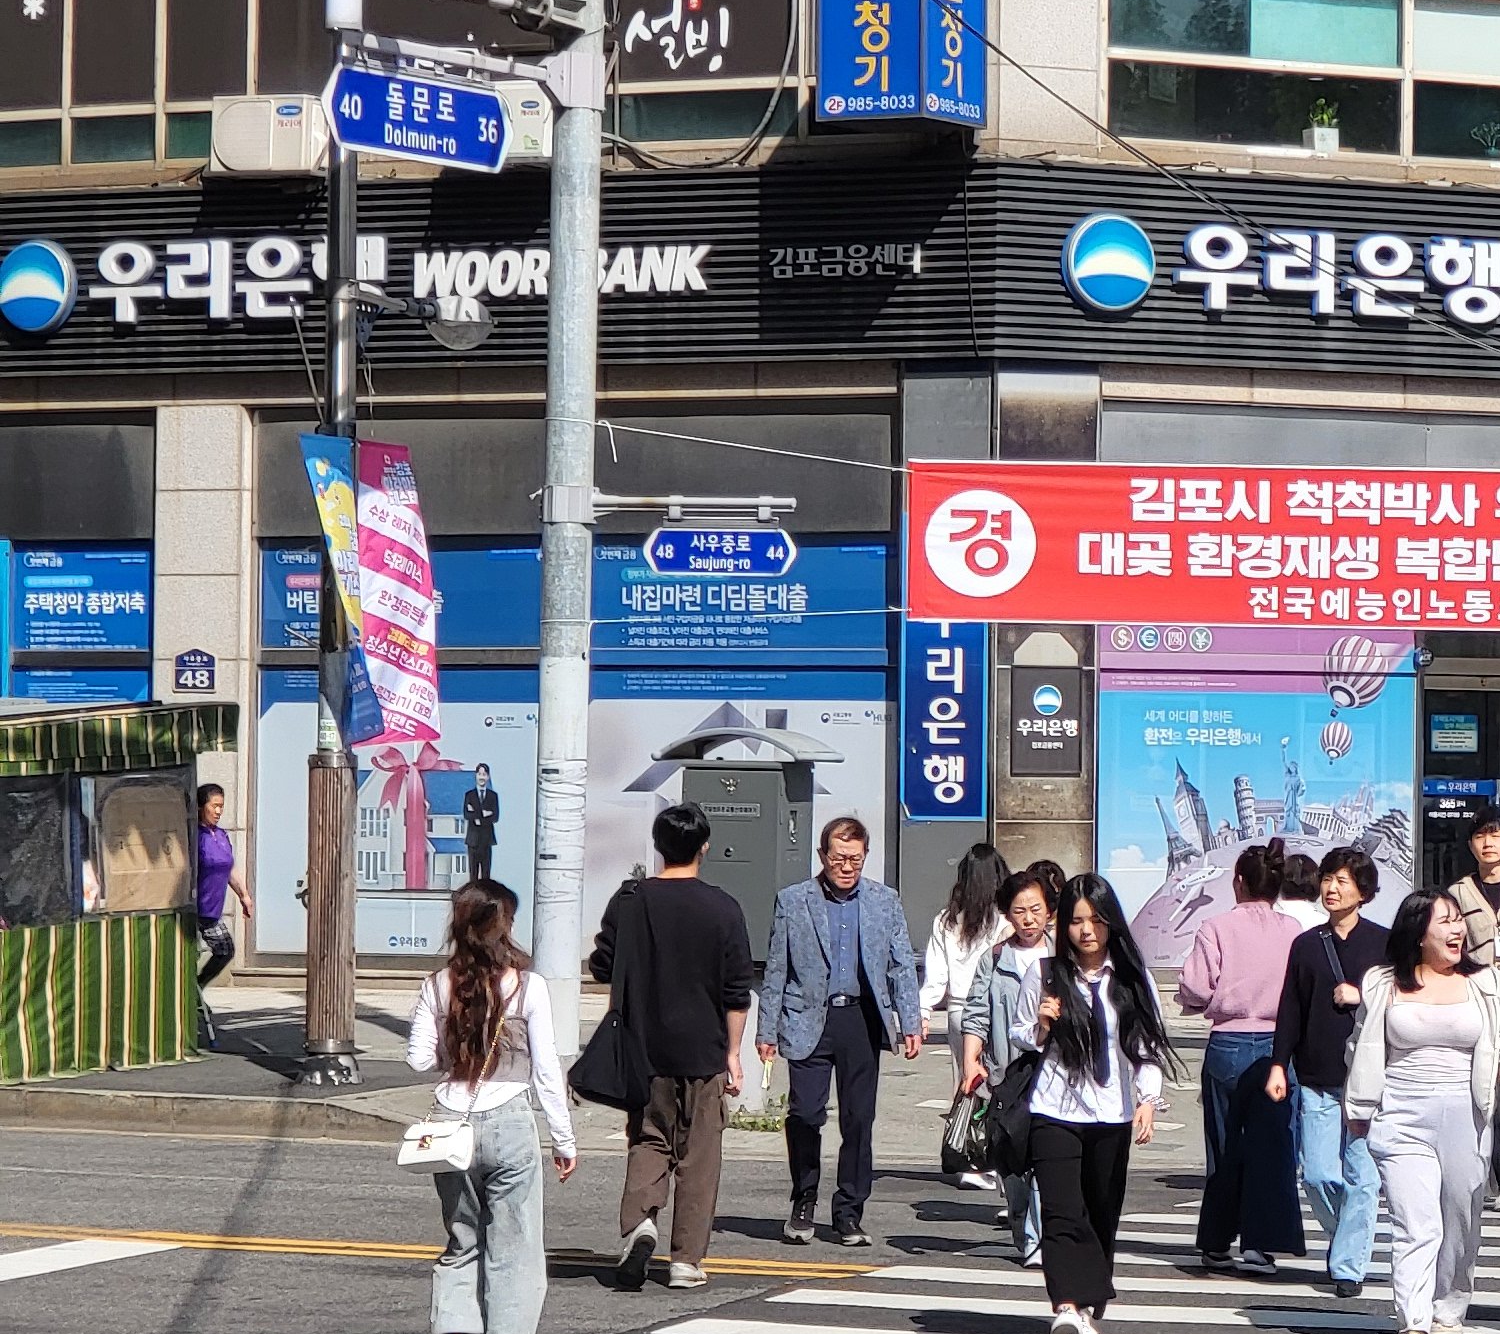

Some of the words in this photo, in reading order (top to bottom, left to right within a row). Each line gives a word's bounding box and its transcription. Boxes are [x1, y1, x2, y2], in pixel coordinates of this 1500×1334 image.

[339, 93, 362, 121] 40
[386, 78, 456, 124] 돌문로
[828, 98, 843, 112] 2F
[847, 95, 916, 113] 985-8033
[928, 95, 938, 110] 2F
[939, 98, 981, 119] 985-8033
[383, 122, 457, 155] Dolmun-ro
[477, 117, 498, 145] 36
[413, 248, 551, 299] WOOR
[768, 242, 922, 279] 김포금융센터
[1128, 478, 1271, 528] 김포시
[1287, 480, 1480, 529] 척척박사
[655, 544, 674, 559] 48
[690, 534, 752, 554] 사우중로
[765, 545, 785, 561] 44
[948, 509, 1012, 577] 경
[688, 555, 751, 573] Saujung-ro
[1077, 531, 1172, 577] 대곶
[1186, 532, 1379, 581] 환경재생
[24, 591, 84, 615] 주택청약
[86, 591, 147, 615] 종합저축
[621, 584, 701, 612] 내집마련
[706, 583, 809, 612] 디딤돌대출
[179, 670, 210, 688] 48
[1144, 710, 1166, 724] 세계
[1169, 710, 1198, 724] 어디를
[1016, 719, 1079, 737] 우리은행
[1144, 727, 1183, 746] 환전은
[1185, 728, 1262, 746] 우리은행에서
[1447, 782, 1477, 793] 우리은행
[1439, 798, 1456, 809] 365
[400, 937, 427, 947] 우리은행
